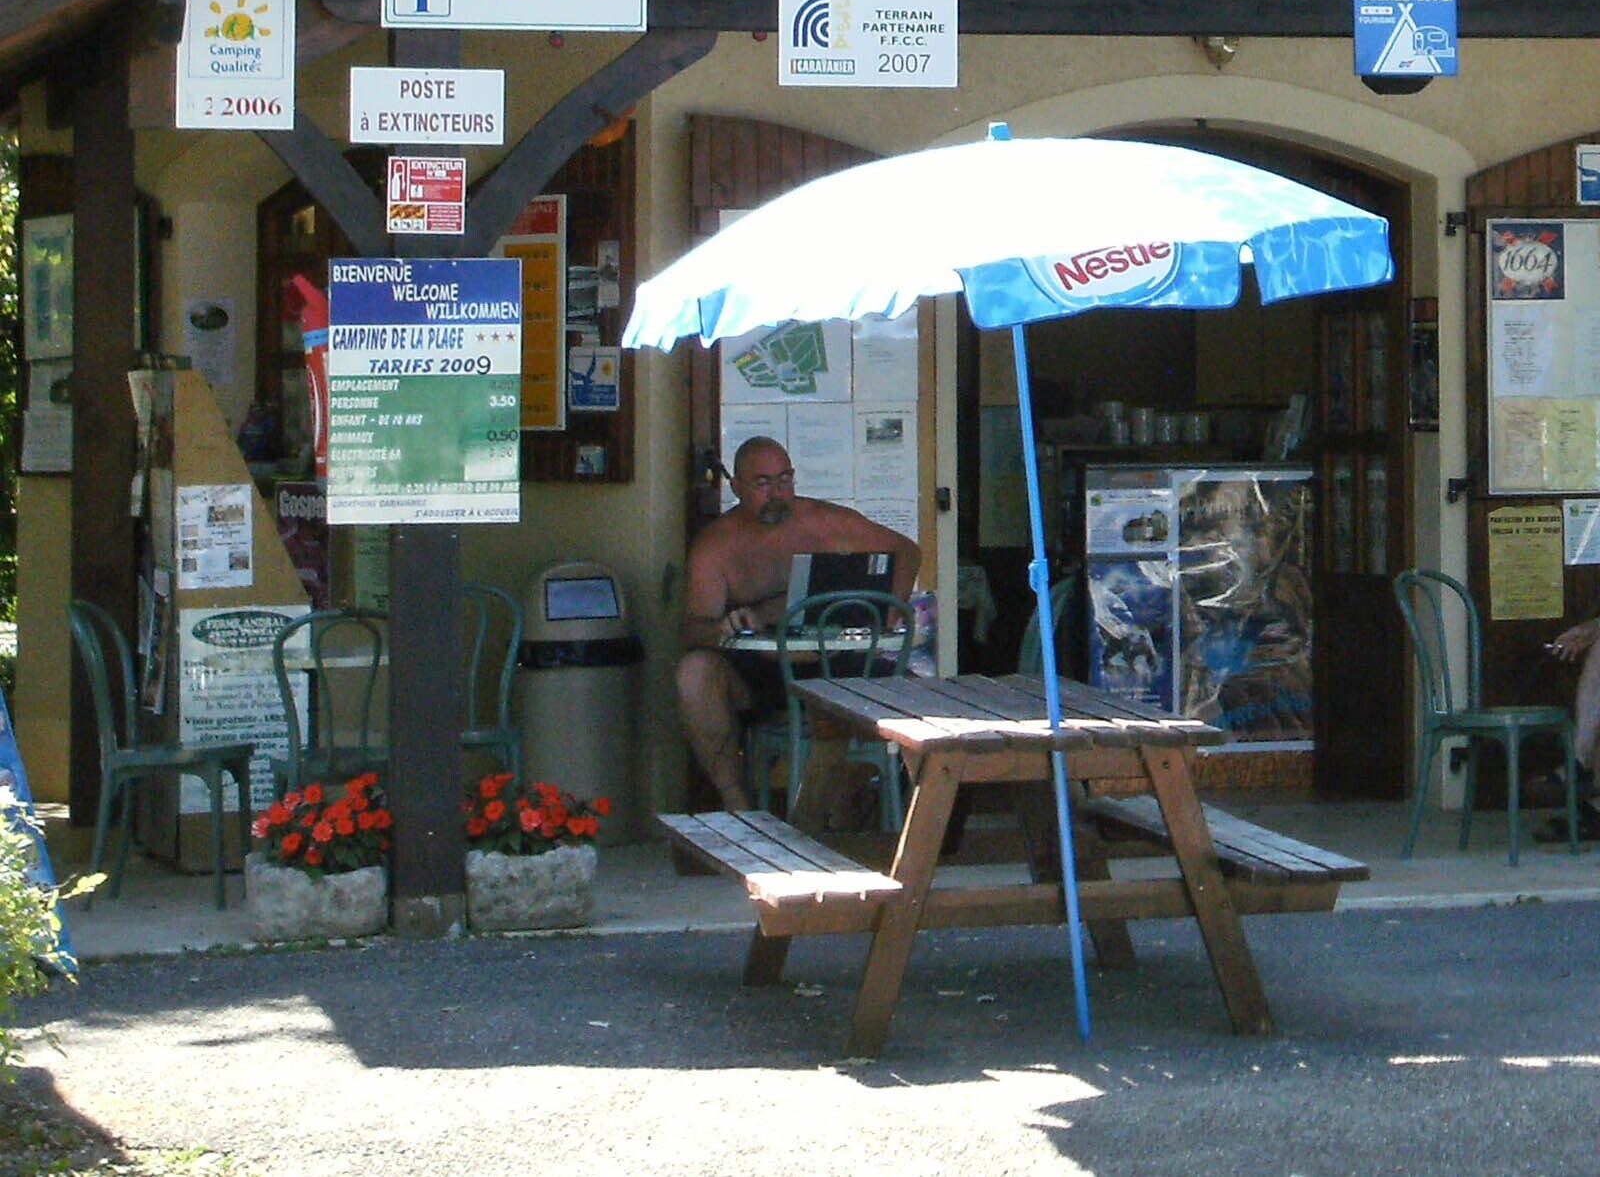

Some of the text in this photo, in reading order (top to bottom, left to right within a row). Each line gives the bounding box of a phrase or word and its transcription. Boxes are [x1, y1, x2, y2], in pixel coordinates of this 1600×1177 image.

[875, 9, 934, 20] TERRAIN
[861, 22, 946, 34] PARTENAIRE
[879, 35, 929, 47] F.F.C.C.
[209, 43, 262, 60] Camping
[210, 59, 257, 73] Qualité
[877, 53, 932, 74] 2007
[400, 79, 456, 99] POSTE
[220, 96, 282, 116] 2006
[360, 111, 495, 133] à EXTINCTEURS
[1503, 246, 1554, 273] 1664
[332, 264, 413, 284] BIENVENUE
[391, 283, 459, 302] WELCOME
[424, 301, 520, 320] WILLKOMMEN
[331, 327, 465, 351] CAMPING DE LA PLAGE
[368, 354, 492, 375] TARIFS 2009
[330, 379, 400, 392] EMPLACEMENT
[330, 396, 380, 410] PERSONNE
[488, 394, 517, 408] 3.50
[331, 413, 367, 427] ENFANT
[404, 413, 424, 427] ANS
[329, 431, 375, 444] ANIMAUX
